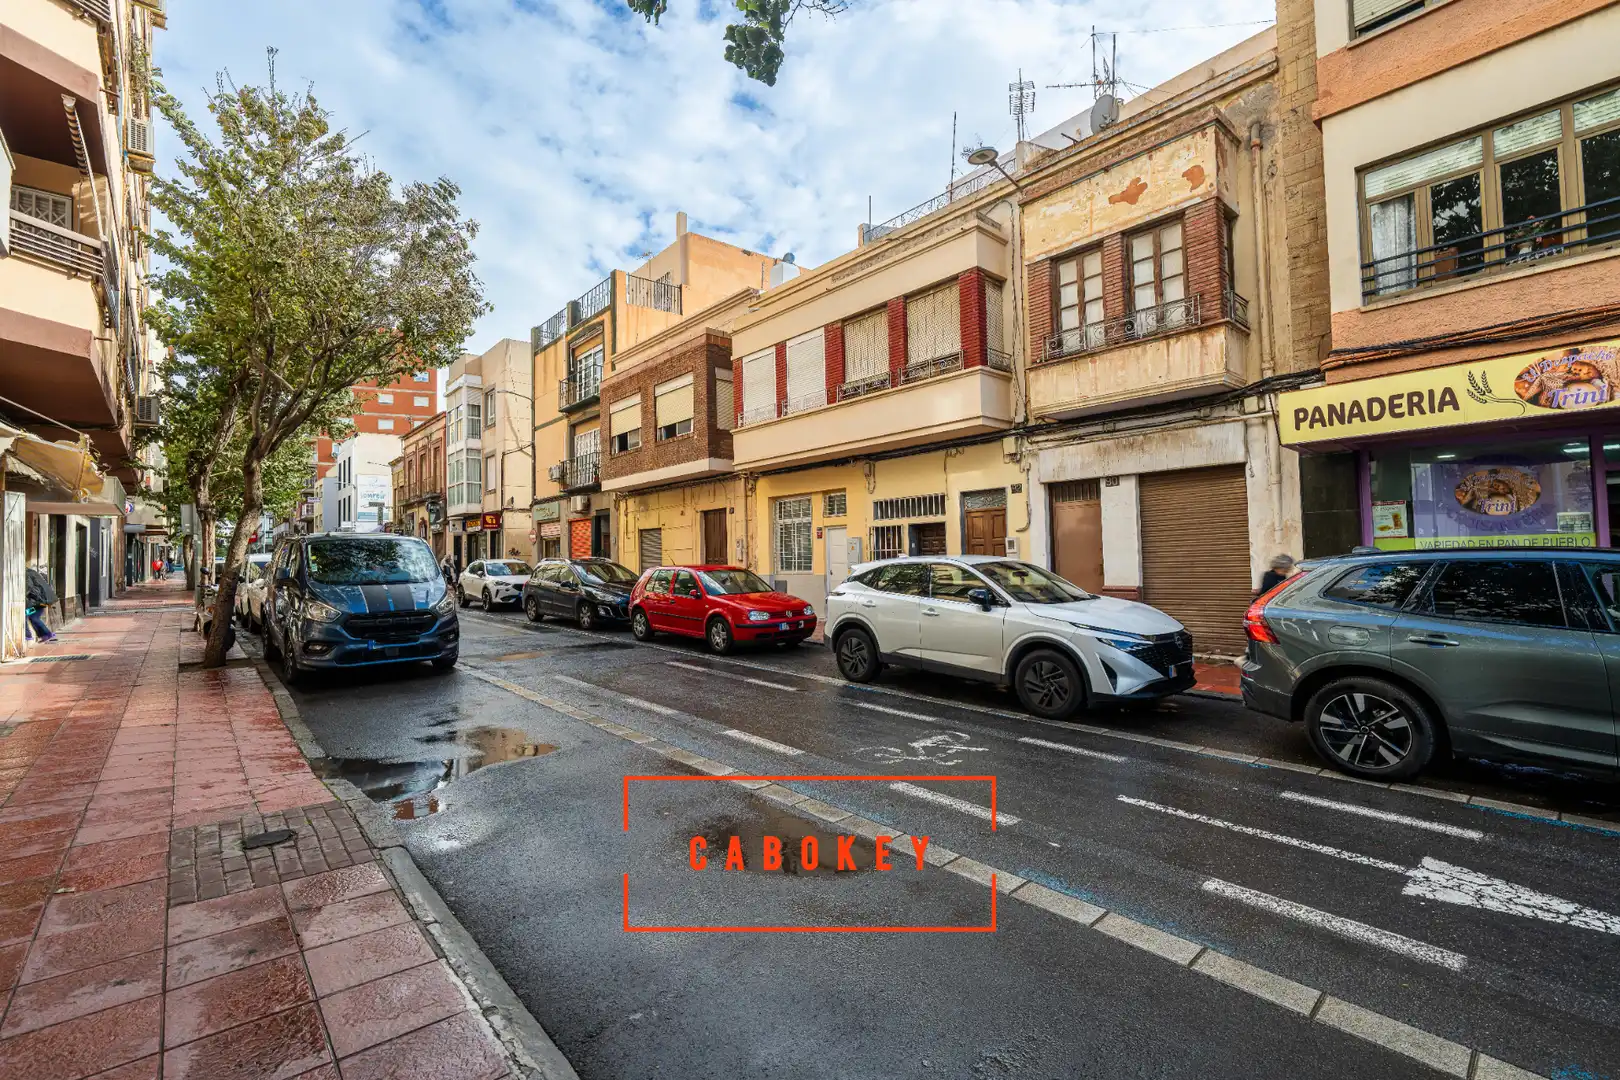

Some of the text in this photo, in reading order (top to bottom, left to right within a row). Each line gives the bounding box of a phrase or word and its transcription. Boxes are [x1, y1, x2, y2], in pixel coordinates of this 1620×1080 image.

[1548, 385, 1608, 408] Trini
[1293, 386, 1460, 431] PANADERIA
[1106, 476, 1118, 486] 90
[1478, 494, 1517, 513] Trini
[1420, 536, 1591, 549] VARIEDAD EN PAN DE PUEBLO
